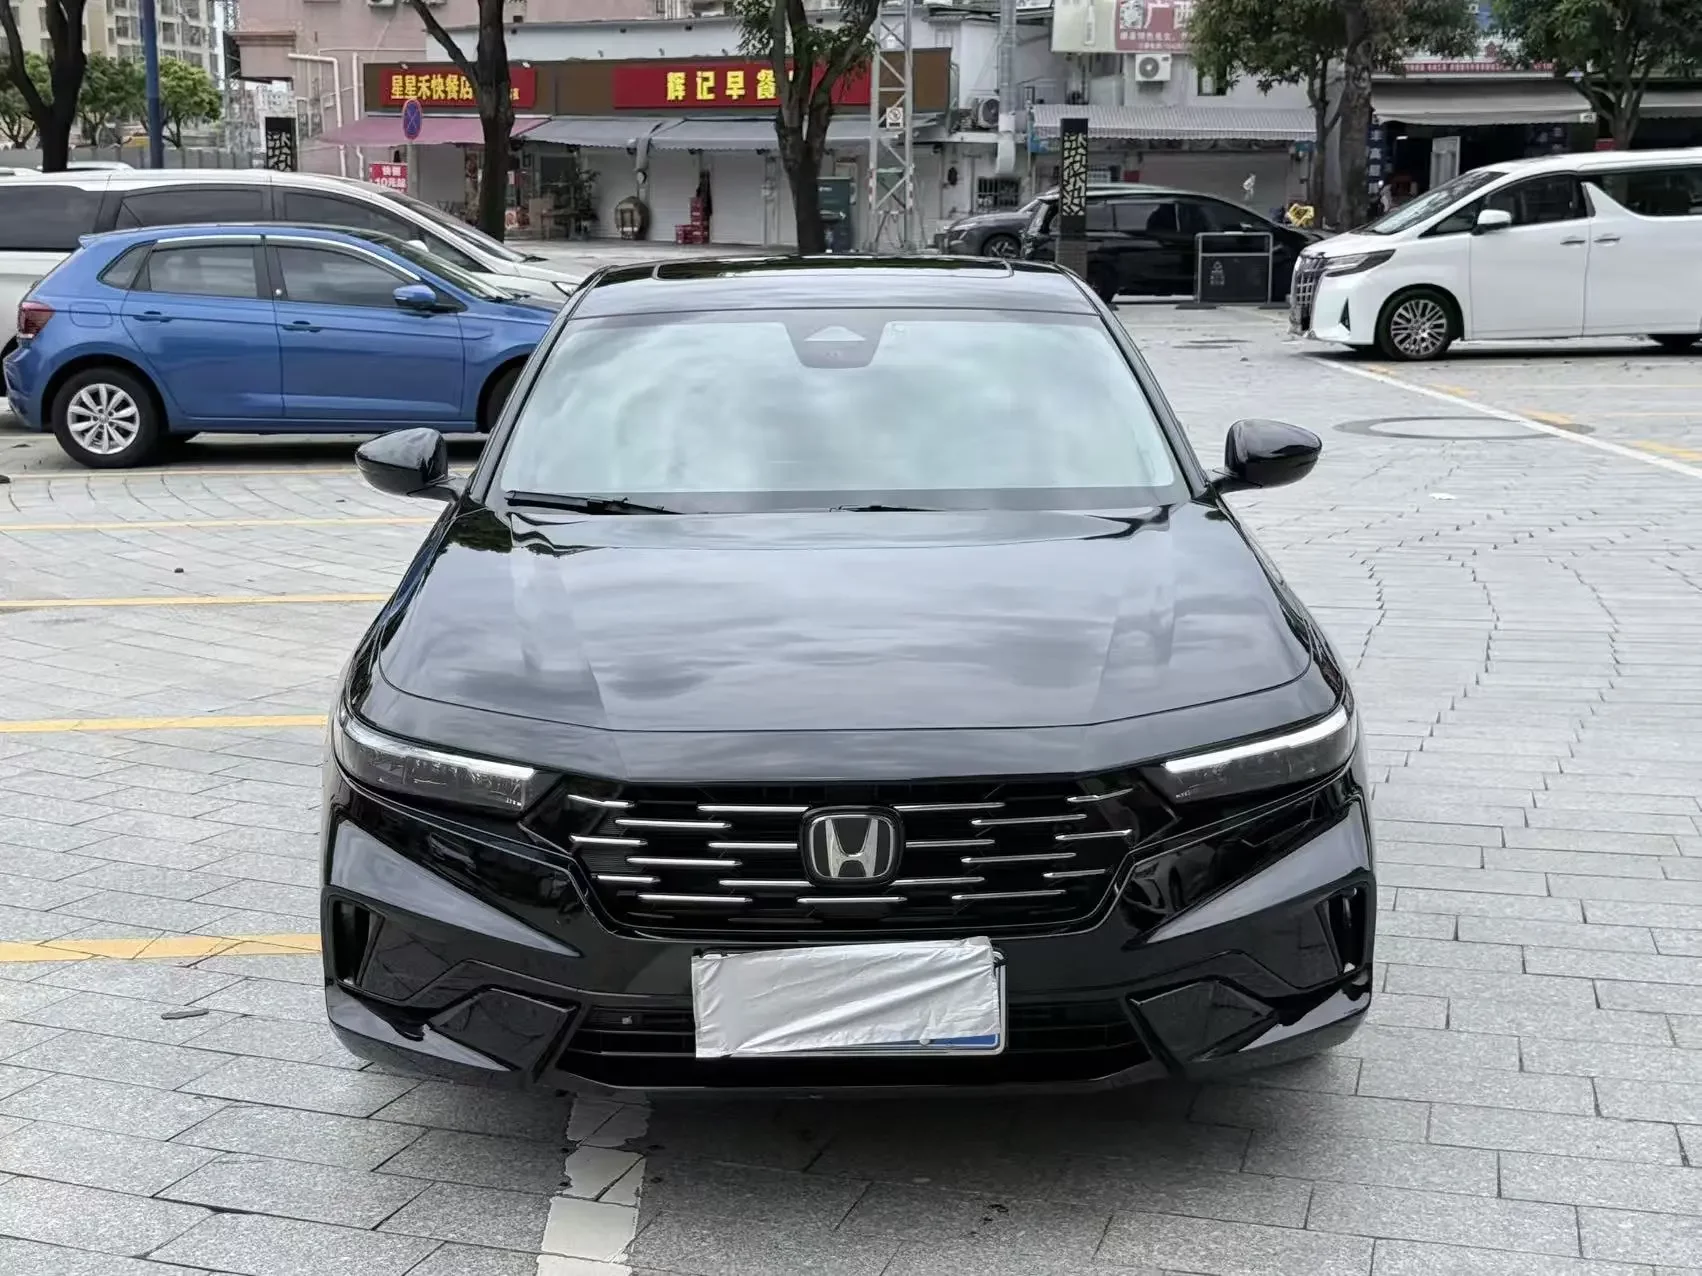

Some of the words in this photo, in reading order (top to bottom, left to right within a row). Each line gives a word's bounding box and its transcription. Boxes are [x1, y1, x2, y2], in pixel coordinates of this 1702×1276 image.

[390, 73, 473, 100] 星星禾快餐店
[666, 68, 793, 101] 辉记早餐
